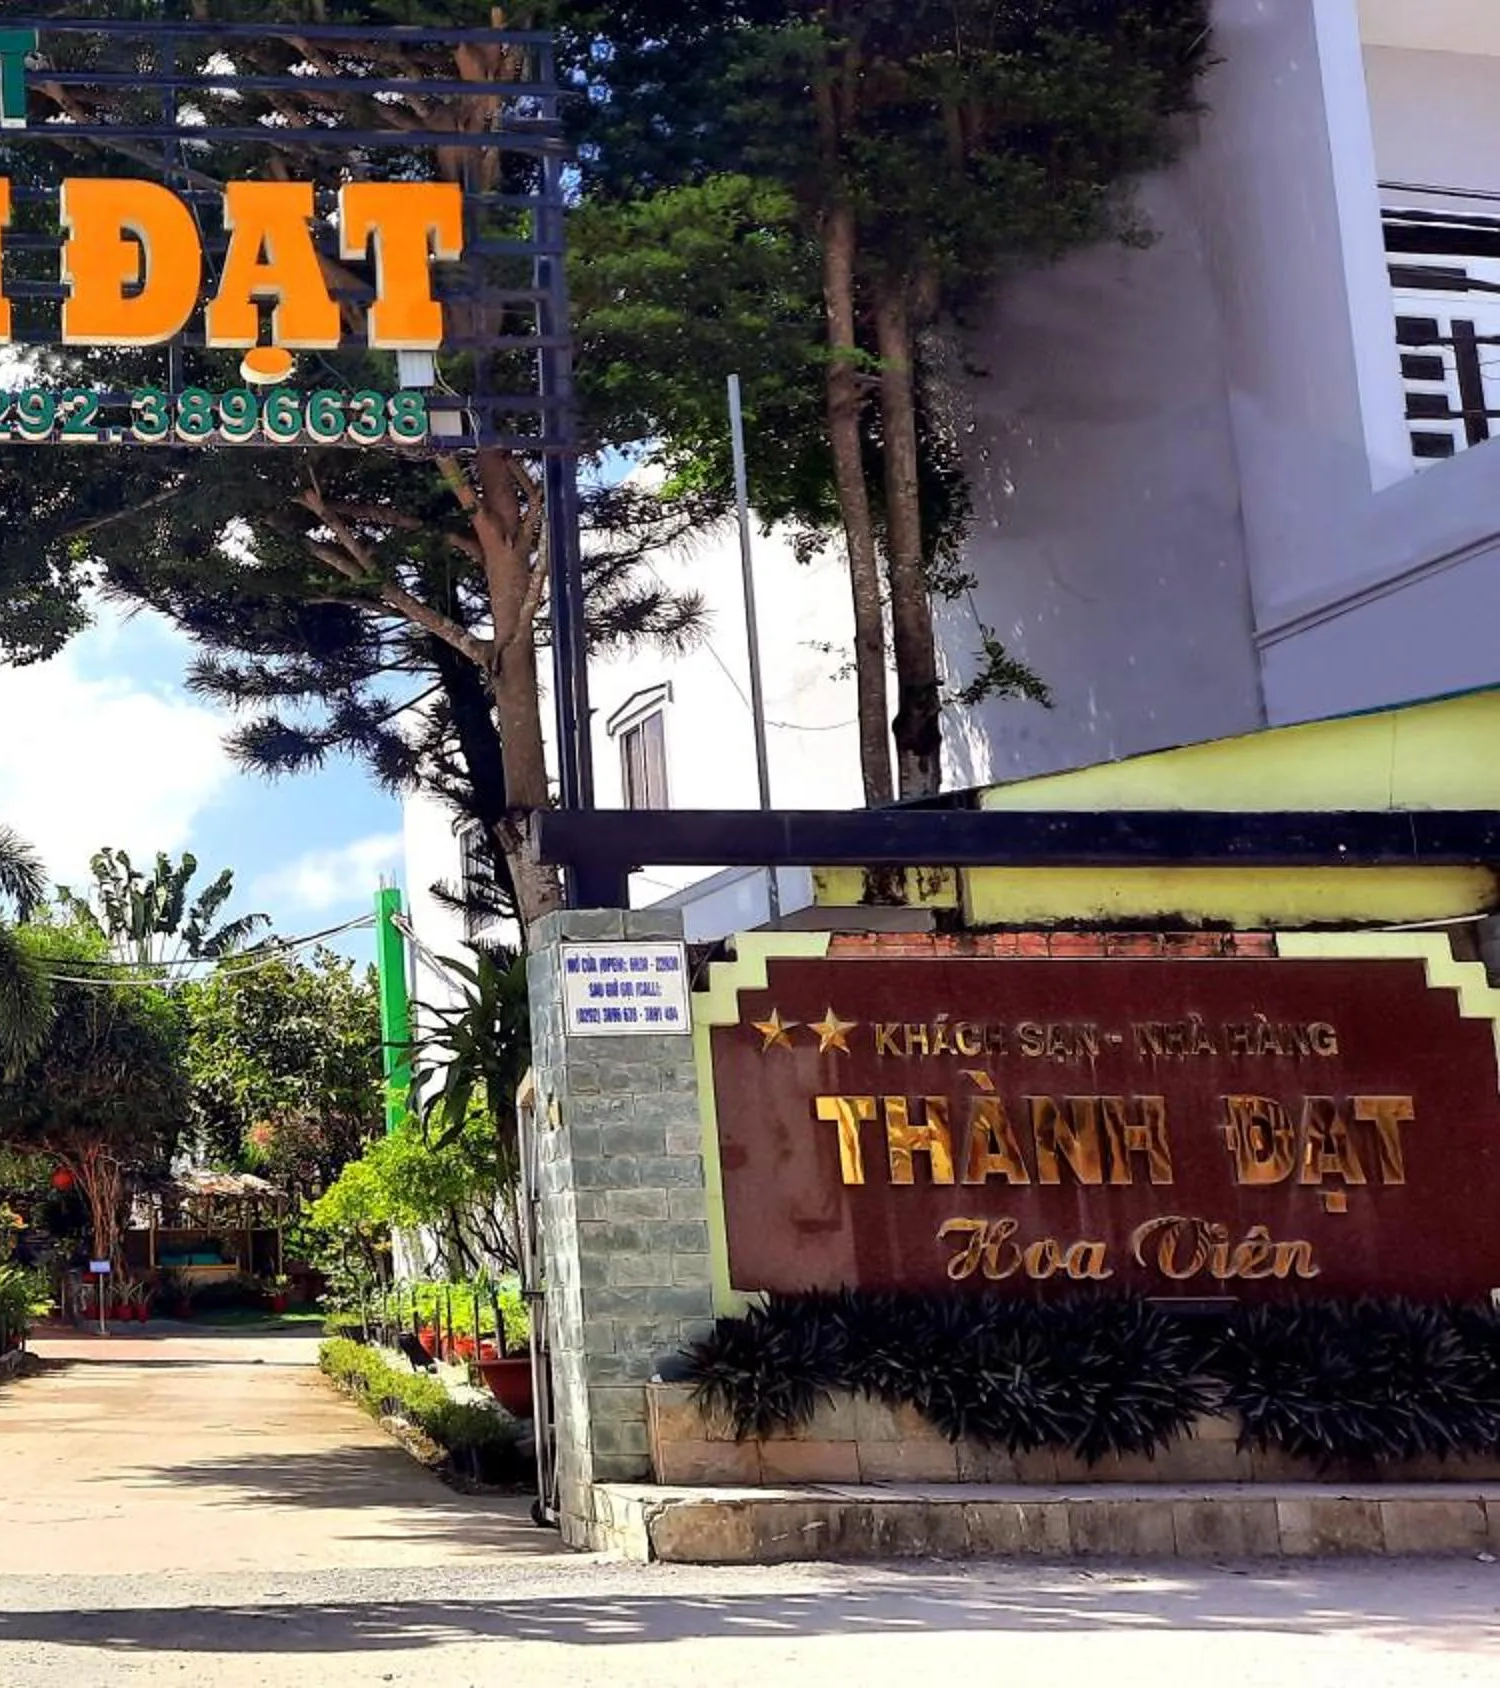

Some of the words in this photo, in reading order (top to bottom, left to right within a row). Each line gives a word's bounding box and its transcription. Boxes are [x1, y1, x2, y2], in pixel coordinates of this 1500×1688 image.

[60, 177, 464, 385] ĐẠT
[874, 1013, 1007, 1057] KHÁCH
[1017, 1020, 1100, 1063] SẠN
[1225, 1012, 1339, 1057] HÀNG
[815, 1068, 1175, 1186] THÀNH
[1219, 1094, 1415, 1213] ĐẠT
[936, 1215, 1115, 1281] Hoa
[1132, 1214, 1322, 1281] Viên
